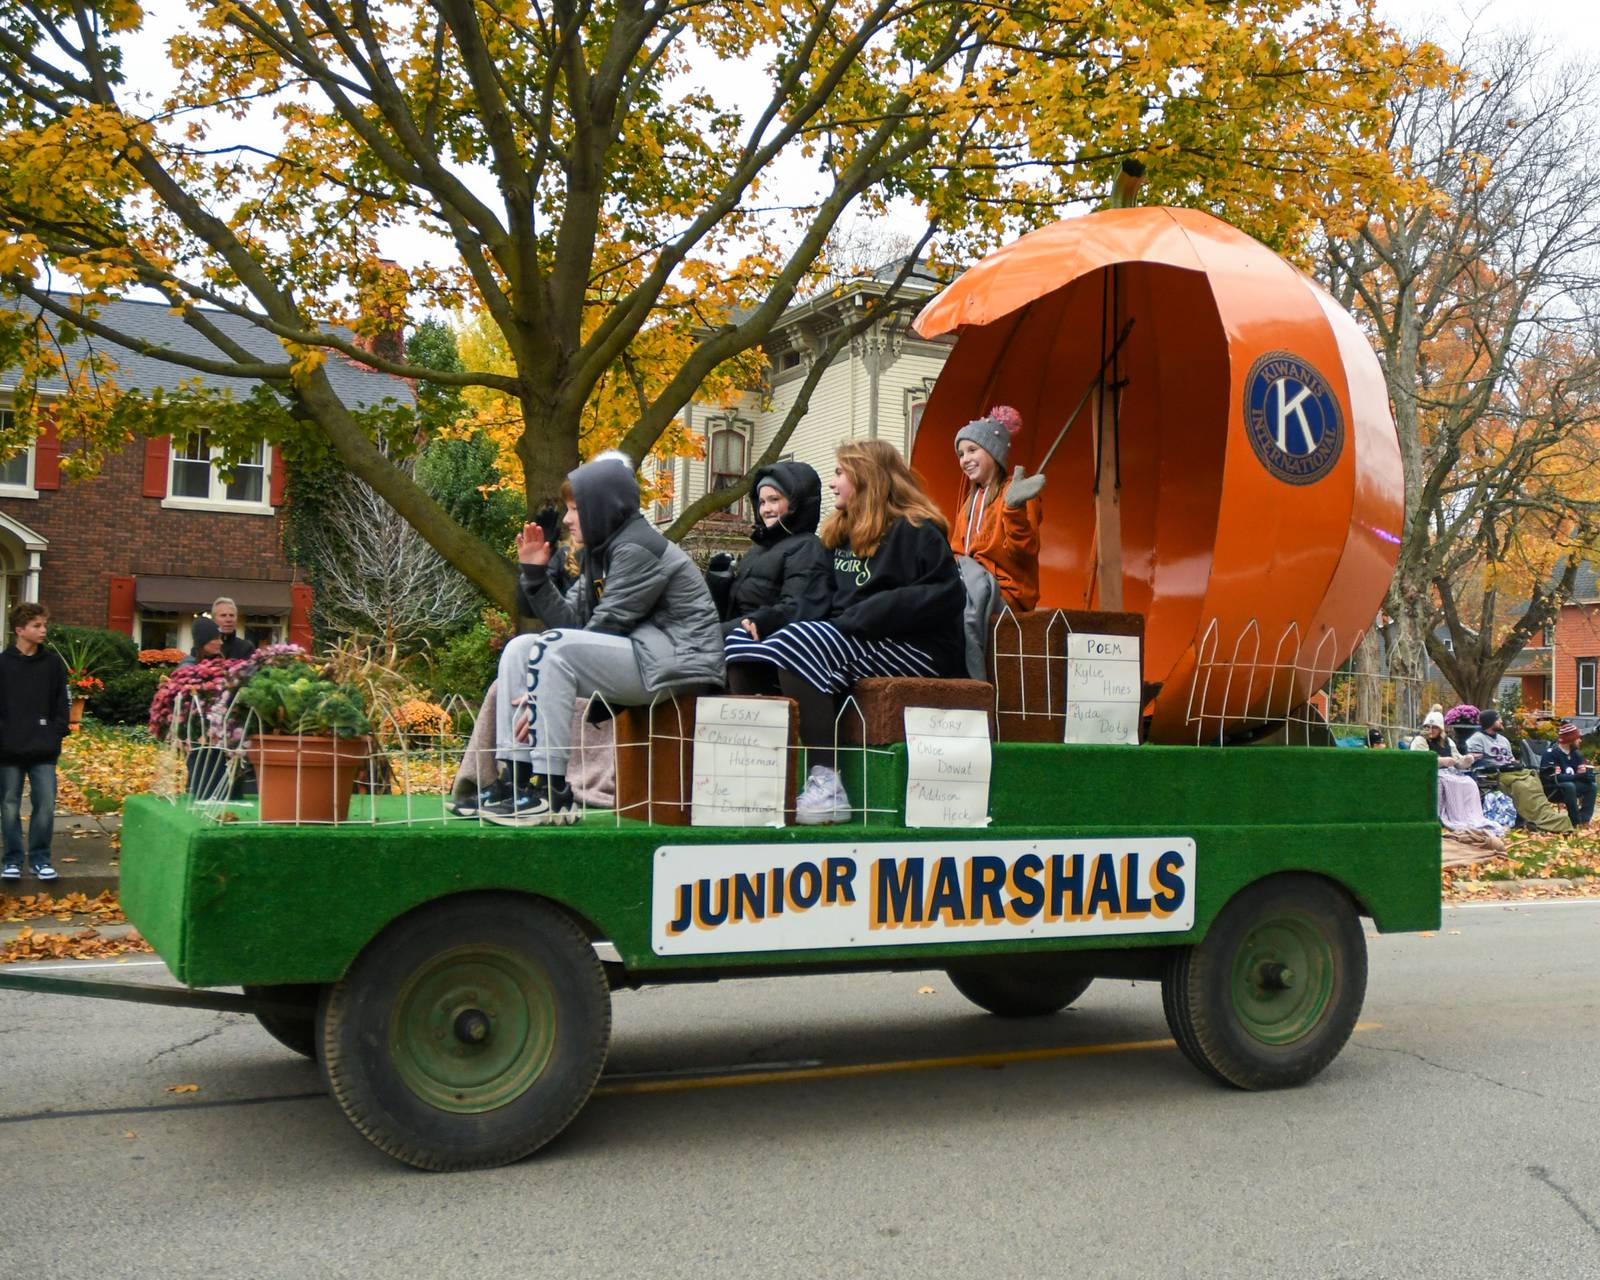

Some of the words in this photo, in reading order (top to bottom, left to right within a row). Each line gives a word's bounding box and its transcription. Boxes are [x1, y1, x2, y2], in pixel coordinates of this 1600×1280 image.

[1261, 360, 1326, 397] KIWANIS
[1275, 377, 1317, 454] K
[1252, 408, 1336, 475] INTERNATIONAL
[1087, 639, 1122, 656] POEM
[719, 703, 761, 721] ESSAY
[929, 715, 963, 730] STORY
[666, 857, 857, 936] JUNIOR
[869, 850, 1186, 930] MARSHALS
